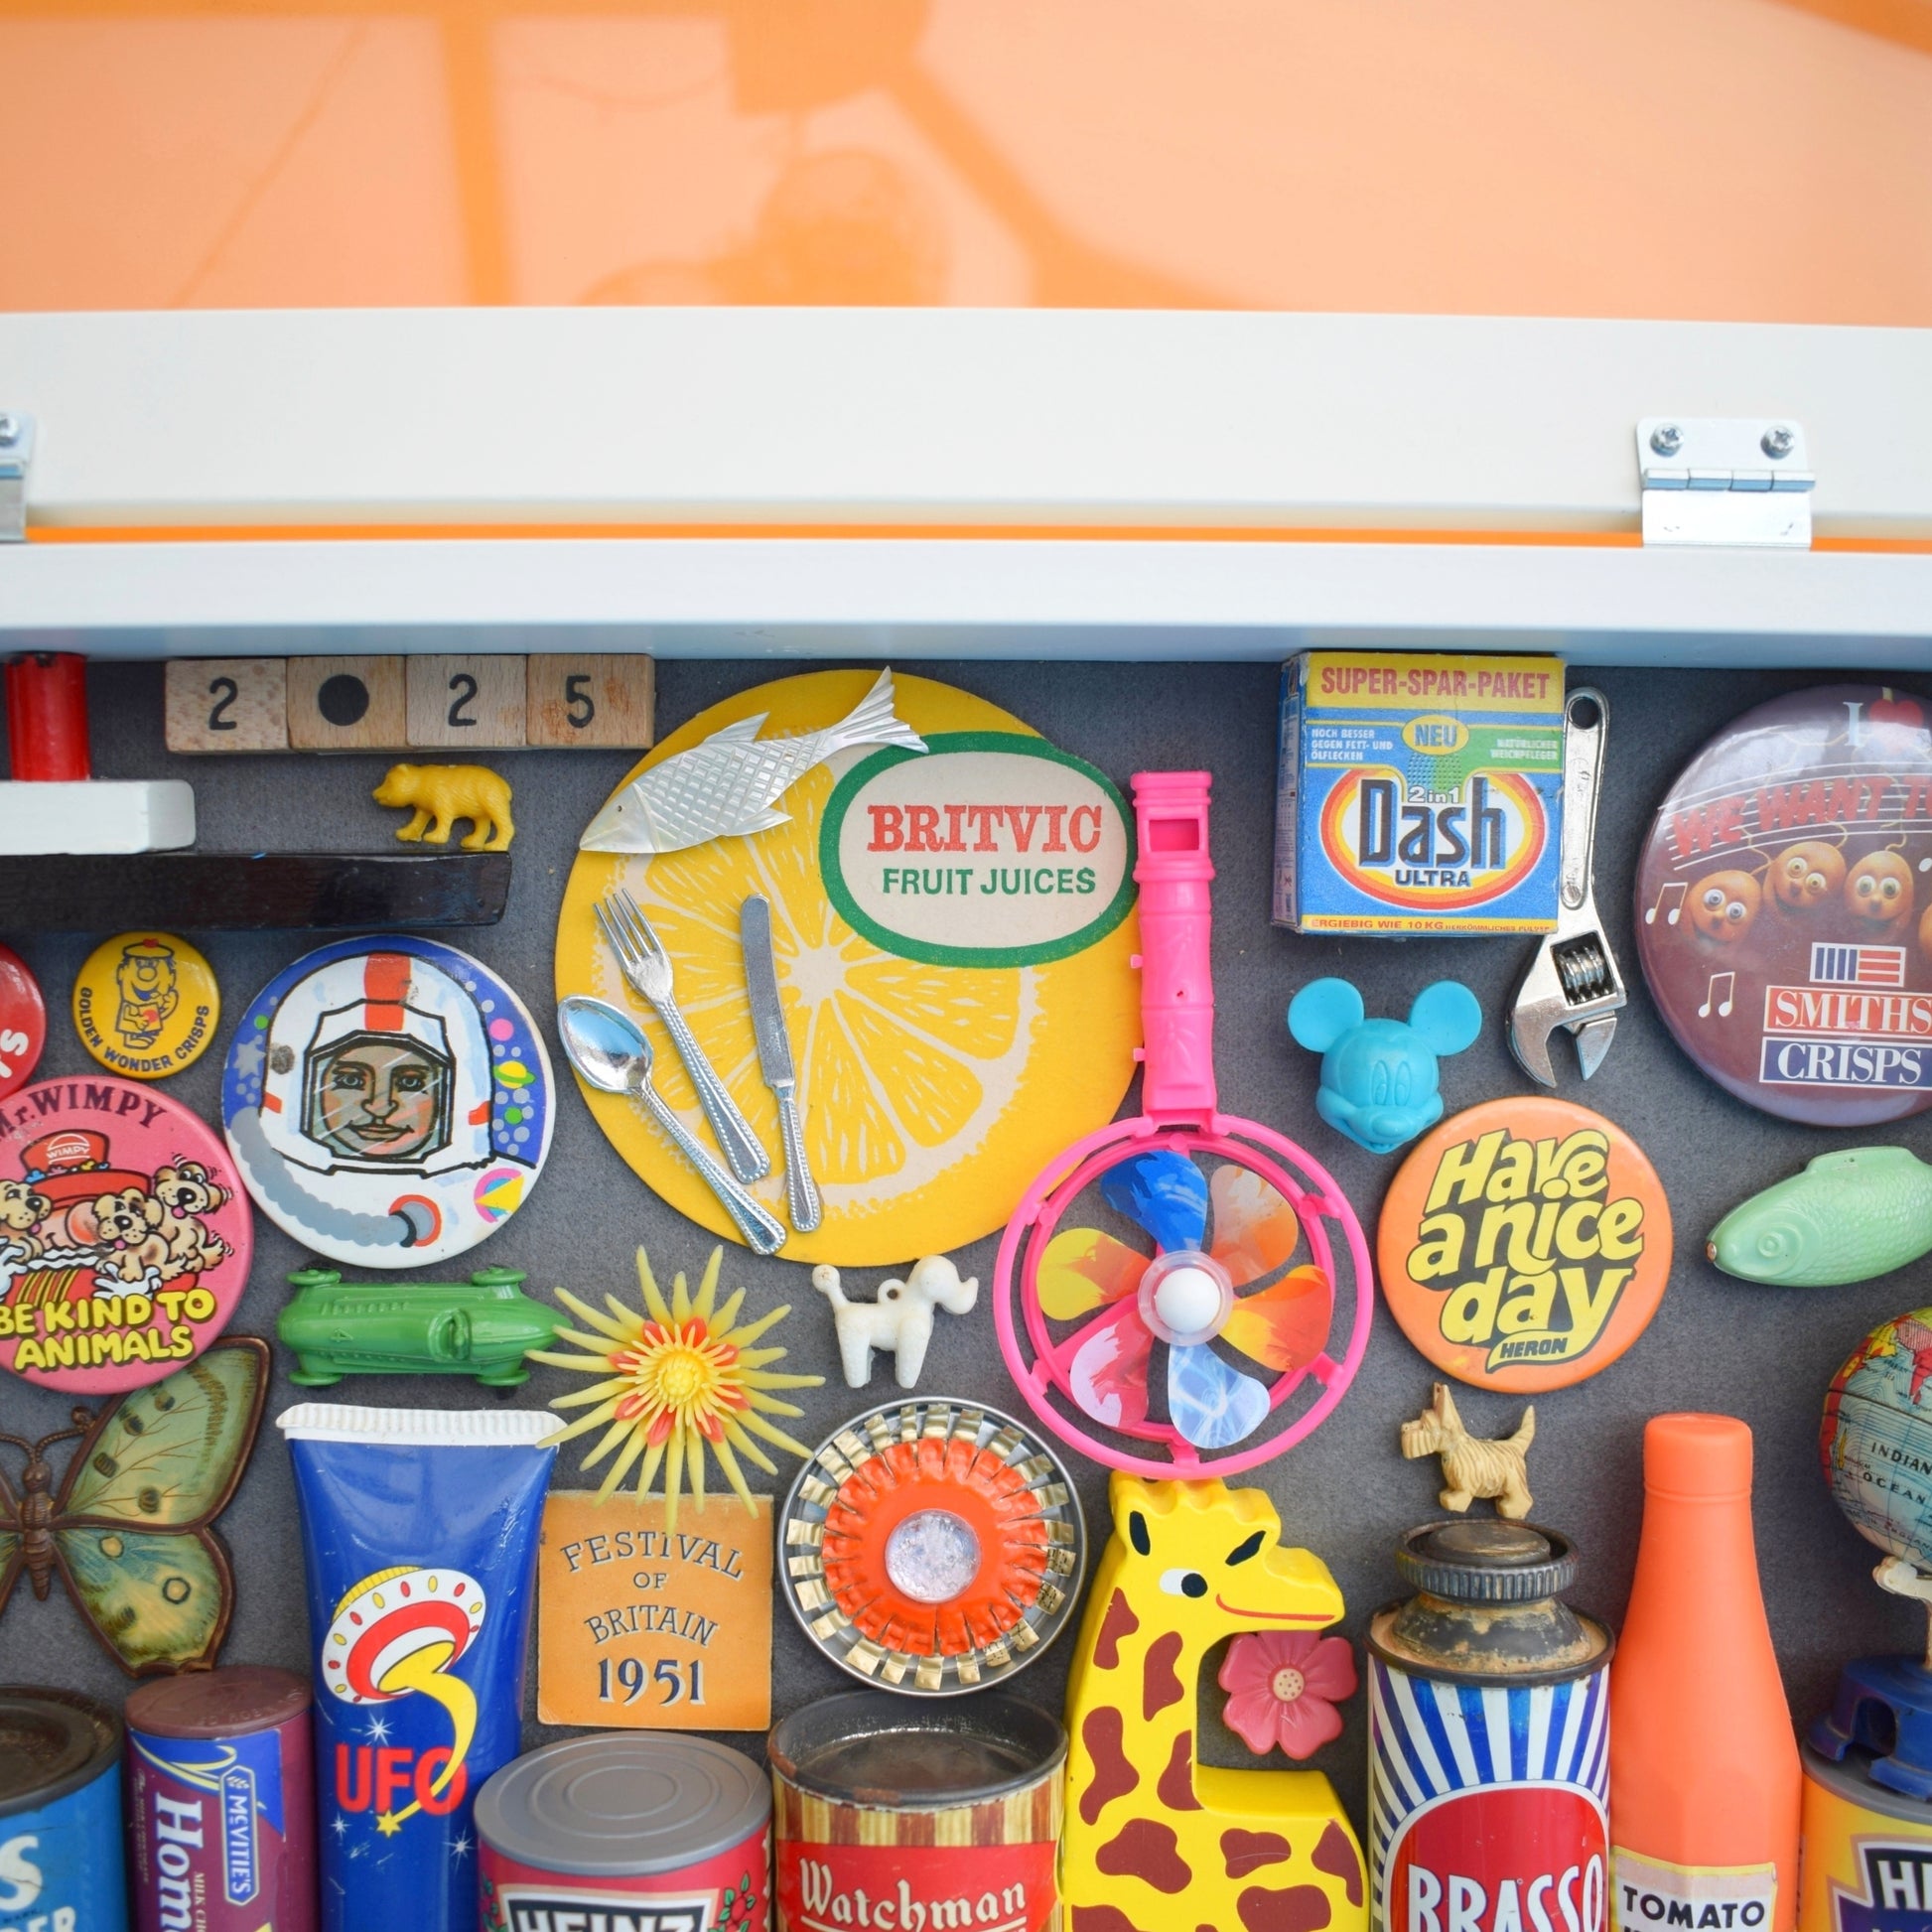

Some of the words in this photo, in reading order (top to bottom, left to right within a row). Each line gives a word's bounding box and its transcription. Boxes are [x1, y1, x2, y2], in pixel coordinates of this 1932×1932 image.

[208, 677, 239, 732] 2
[447, 673, 478, 727] 2
[565, 674, 596, 728] 5
[1320, 666, 1550, 700] SUPER-SPAR-PAKET
[1311, 729, 1337, 739] NOCH
[1341, 729, 1375, 739] BESSER
[1311, 740, 1342, 750] GEGEN
[1345, 741, 1370, 750] FETT-
[1372, 741, 1394, 751] UND
[1414, 724, 1457, 748] NEU
[1843, 701, 1863, 748] I
[1311, 749, 1364, 760] ÖLFLECKEN
[867, 804, 1102, 854] BRITVIC
[1358, 776, 1506, 871] Dash
[1673, 798, 1745, 856] WE
[1756, 776, 1891, 830] WANT
[1903, 775, 1932, 820] T
[883, 868, 974, 896] FRUIT
[980, 867, 1097, 896] JUICES
[1395, 870, 1471, 888] ULTRA
[1311, 919, 1373, 929] ERGIEBIG
[1377, 920, 1402, 929] WIE
[78, 986, 104, 1048] GOLDEN
[104, 1046, 174, 1073] WONDER
[175, 1004, 209, 1060] CRISPS
[1775, 992, 1932, 1035] SMITHS
[1777, 1042, 1922, 1085] CRISPS
[28, 1083, 168, 1129] WIMPY
[46, 1146, 90, 1159] WIMPY
[1423, 1128, 1610, 1216] Have
[1407, 1212, 1466, 1283] a
[1474, 1197, 1645, 1276] nice
[44, 1294, 153, 1332] KIND
[156, 1288, 215, 1322] TO
[1440, 1266, 1636, 1374] day
[13, 1325, 195, 1371] ANIMALS
[1499, 1337, 1569, 1359] HERON
[1871, 1442, 1932, 1476] INDIAN
[1863, 1471, 1926, 1505] OCEAN
[560, 1531, 744, 1582] FESTIVAL
[632, 1572, 667, 1589] OF
[584, 1604, 720, 1648] BRITAIN
[598, 1657, 706, 1707] 1951
[335, 1742, 469, 1816] UFO
[156, 1791, 204, 1932] Hom
[194, 1872, 207, 1906] MILK
[799, 1858, 1027, 1932] Watchman
[1623, 1884, 1765, 1929] TOMATO
